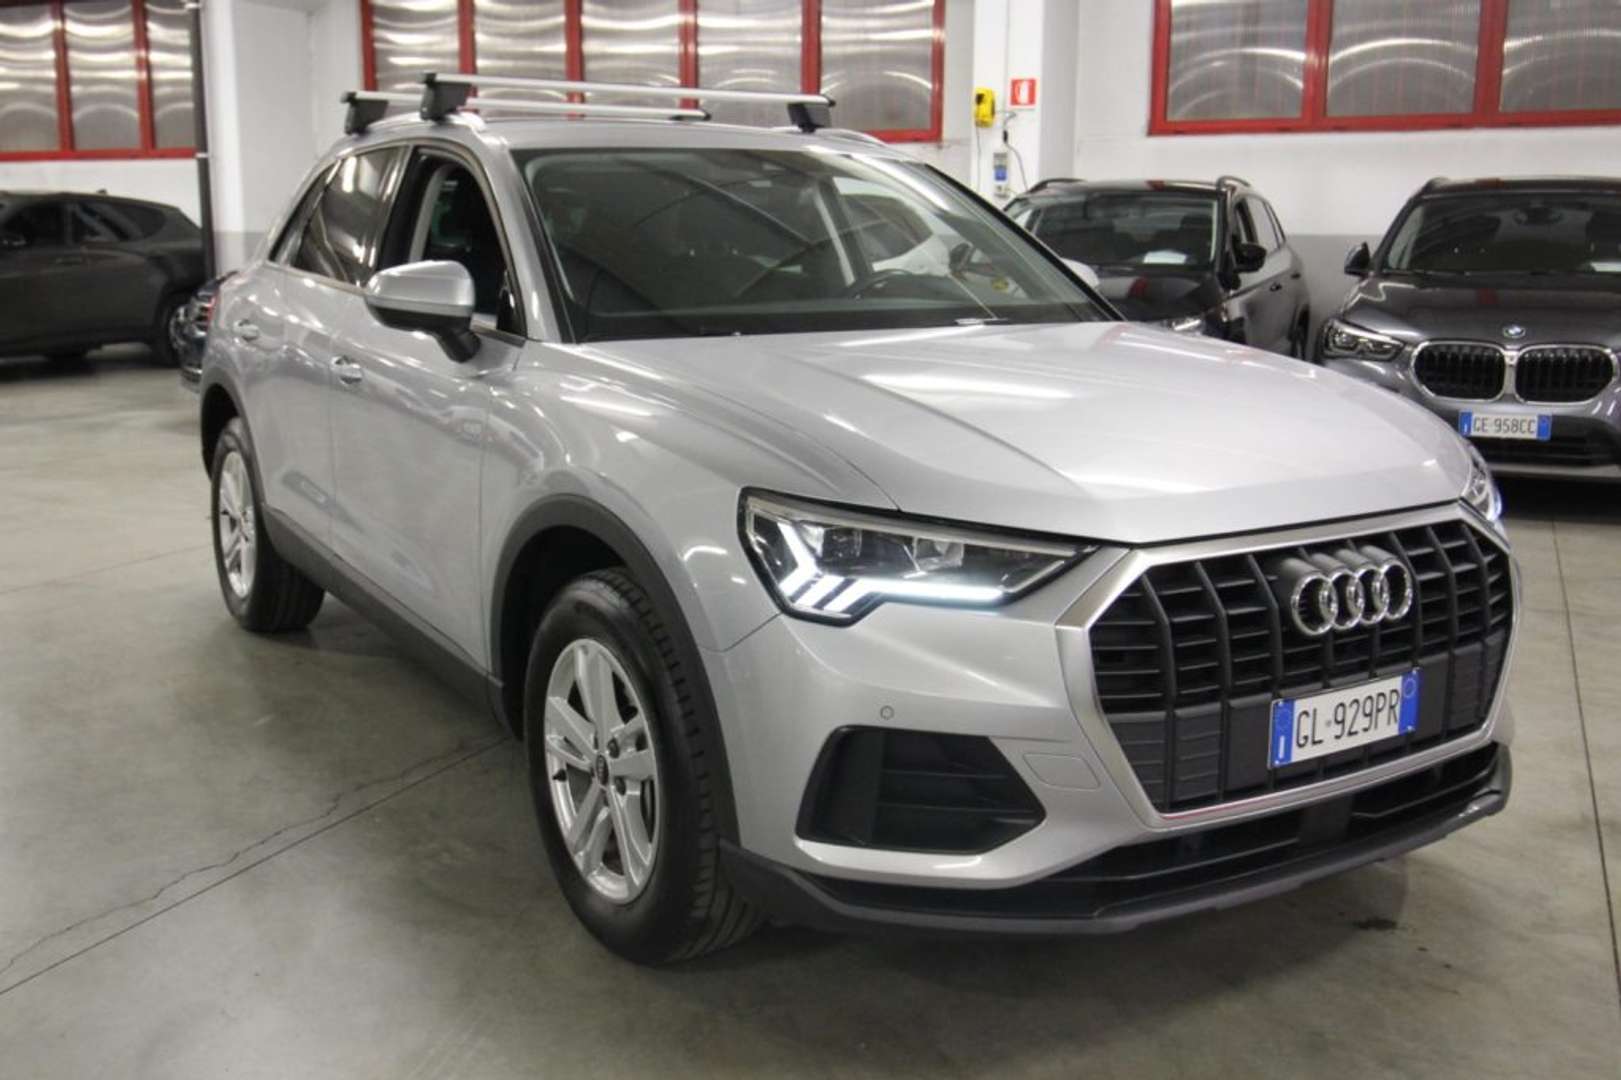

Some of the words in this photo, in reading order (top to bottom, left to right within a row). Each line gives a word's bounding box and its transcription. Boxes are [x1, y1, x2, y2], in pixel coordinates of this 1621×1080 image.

[1494, 417, 1536, 433] 958CC
[1295, 707, 1323, 748] GL
[1333, 688, 1400, 740] 929PR
